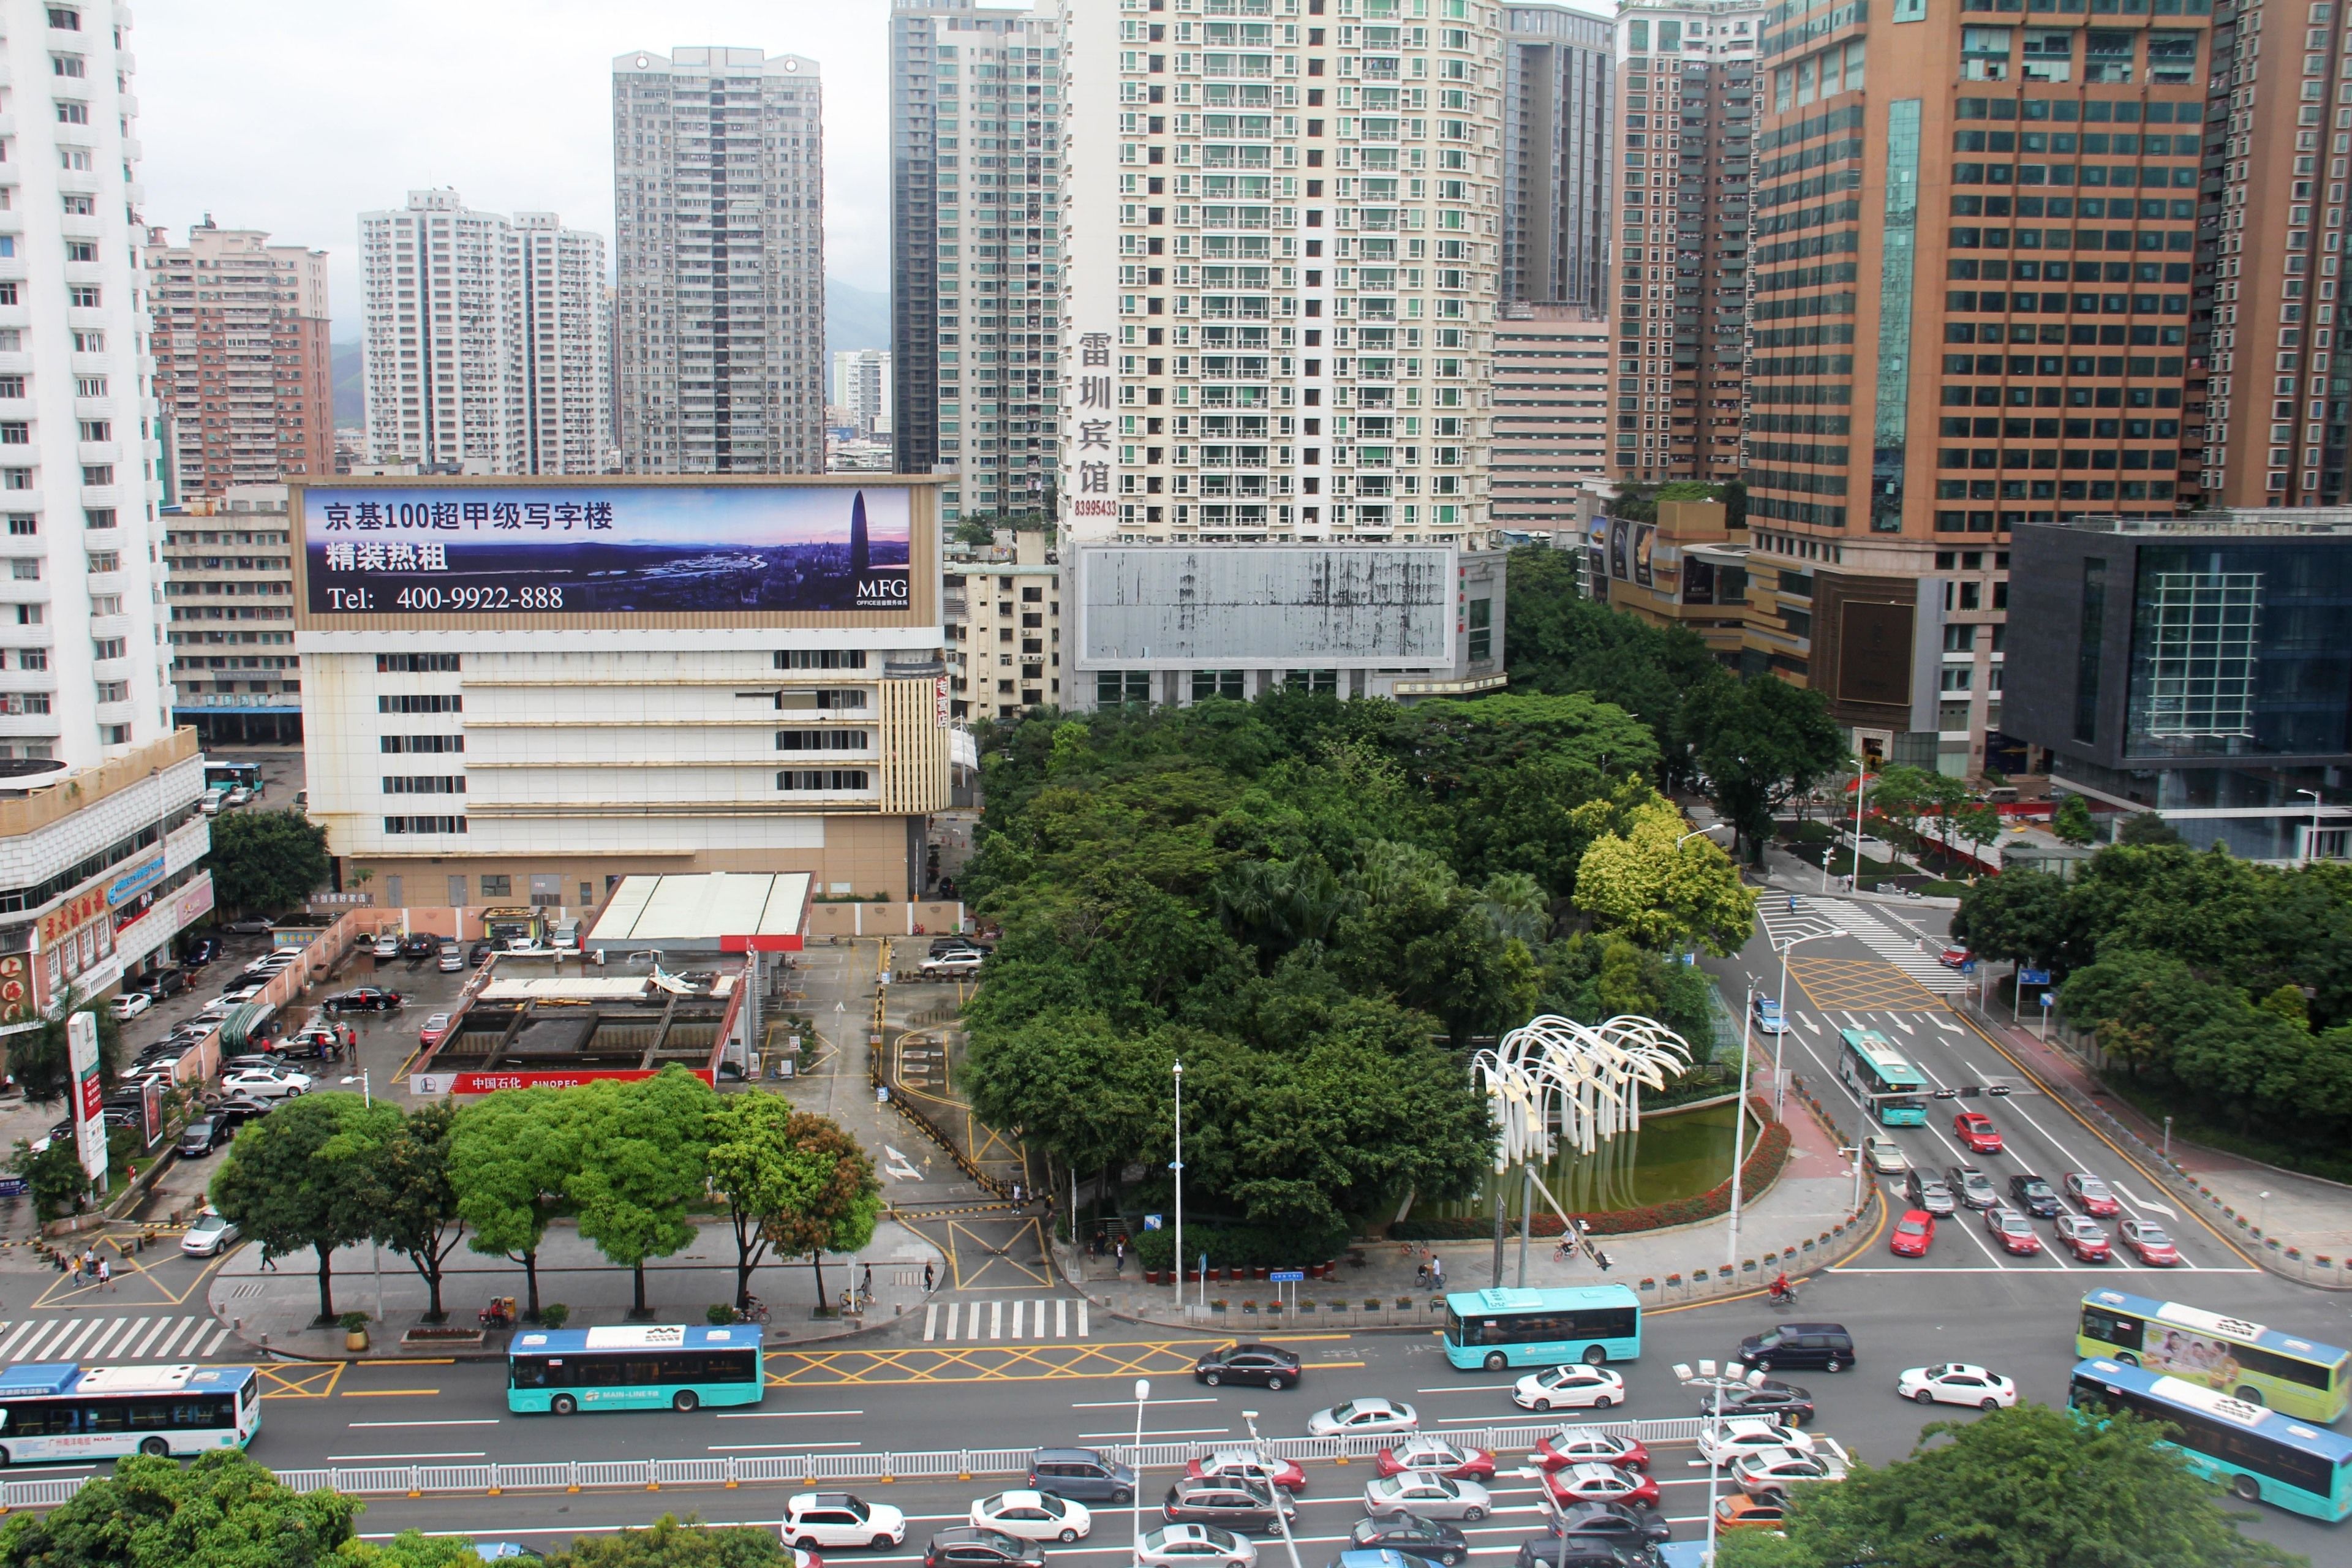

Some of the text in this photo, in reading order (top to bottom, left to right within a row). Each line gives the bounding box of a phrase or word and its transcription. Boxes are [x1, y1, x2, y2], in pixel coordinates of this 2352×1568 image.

[1078, 333, 1112, 494] 雷圳宾馆
[324, 502, 612, 530] 京基100超甲级写字楼
[1075, 500, 1116, 516] 83995433
[326, 542, 448, 571] 精装热租
[327, 585, 564, 611] Tel: 400-9922-888
[856, 579, 908, 598] MFG
[473, 1077, 521, 1089] 中国石化
